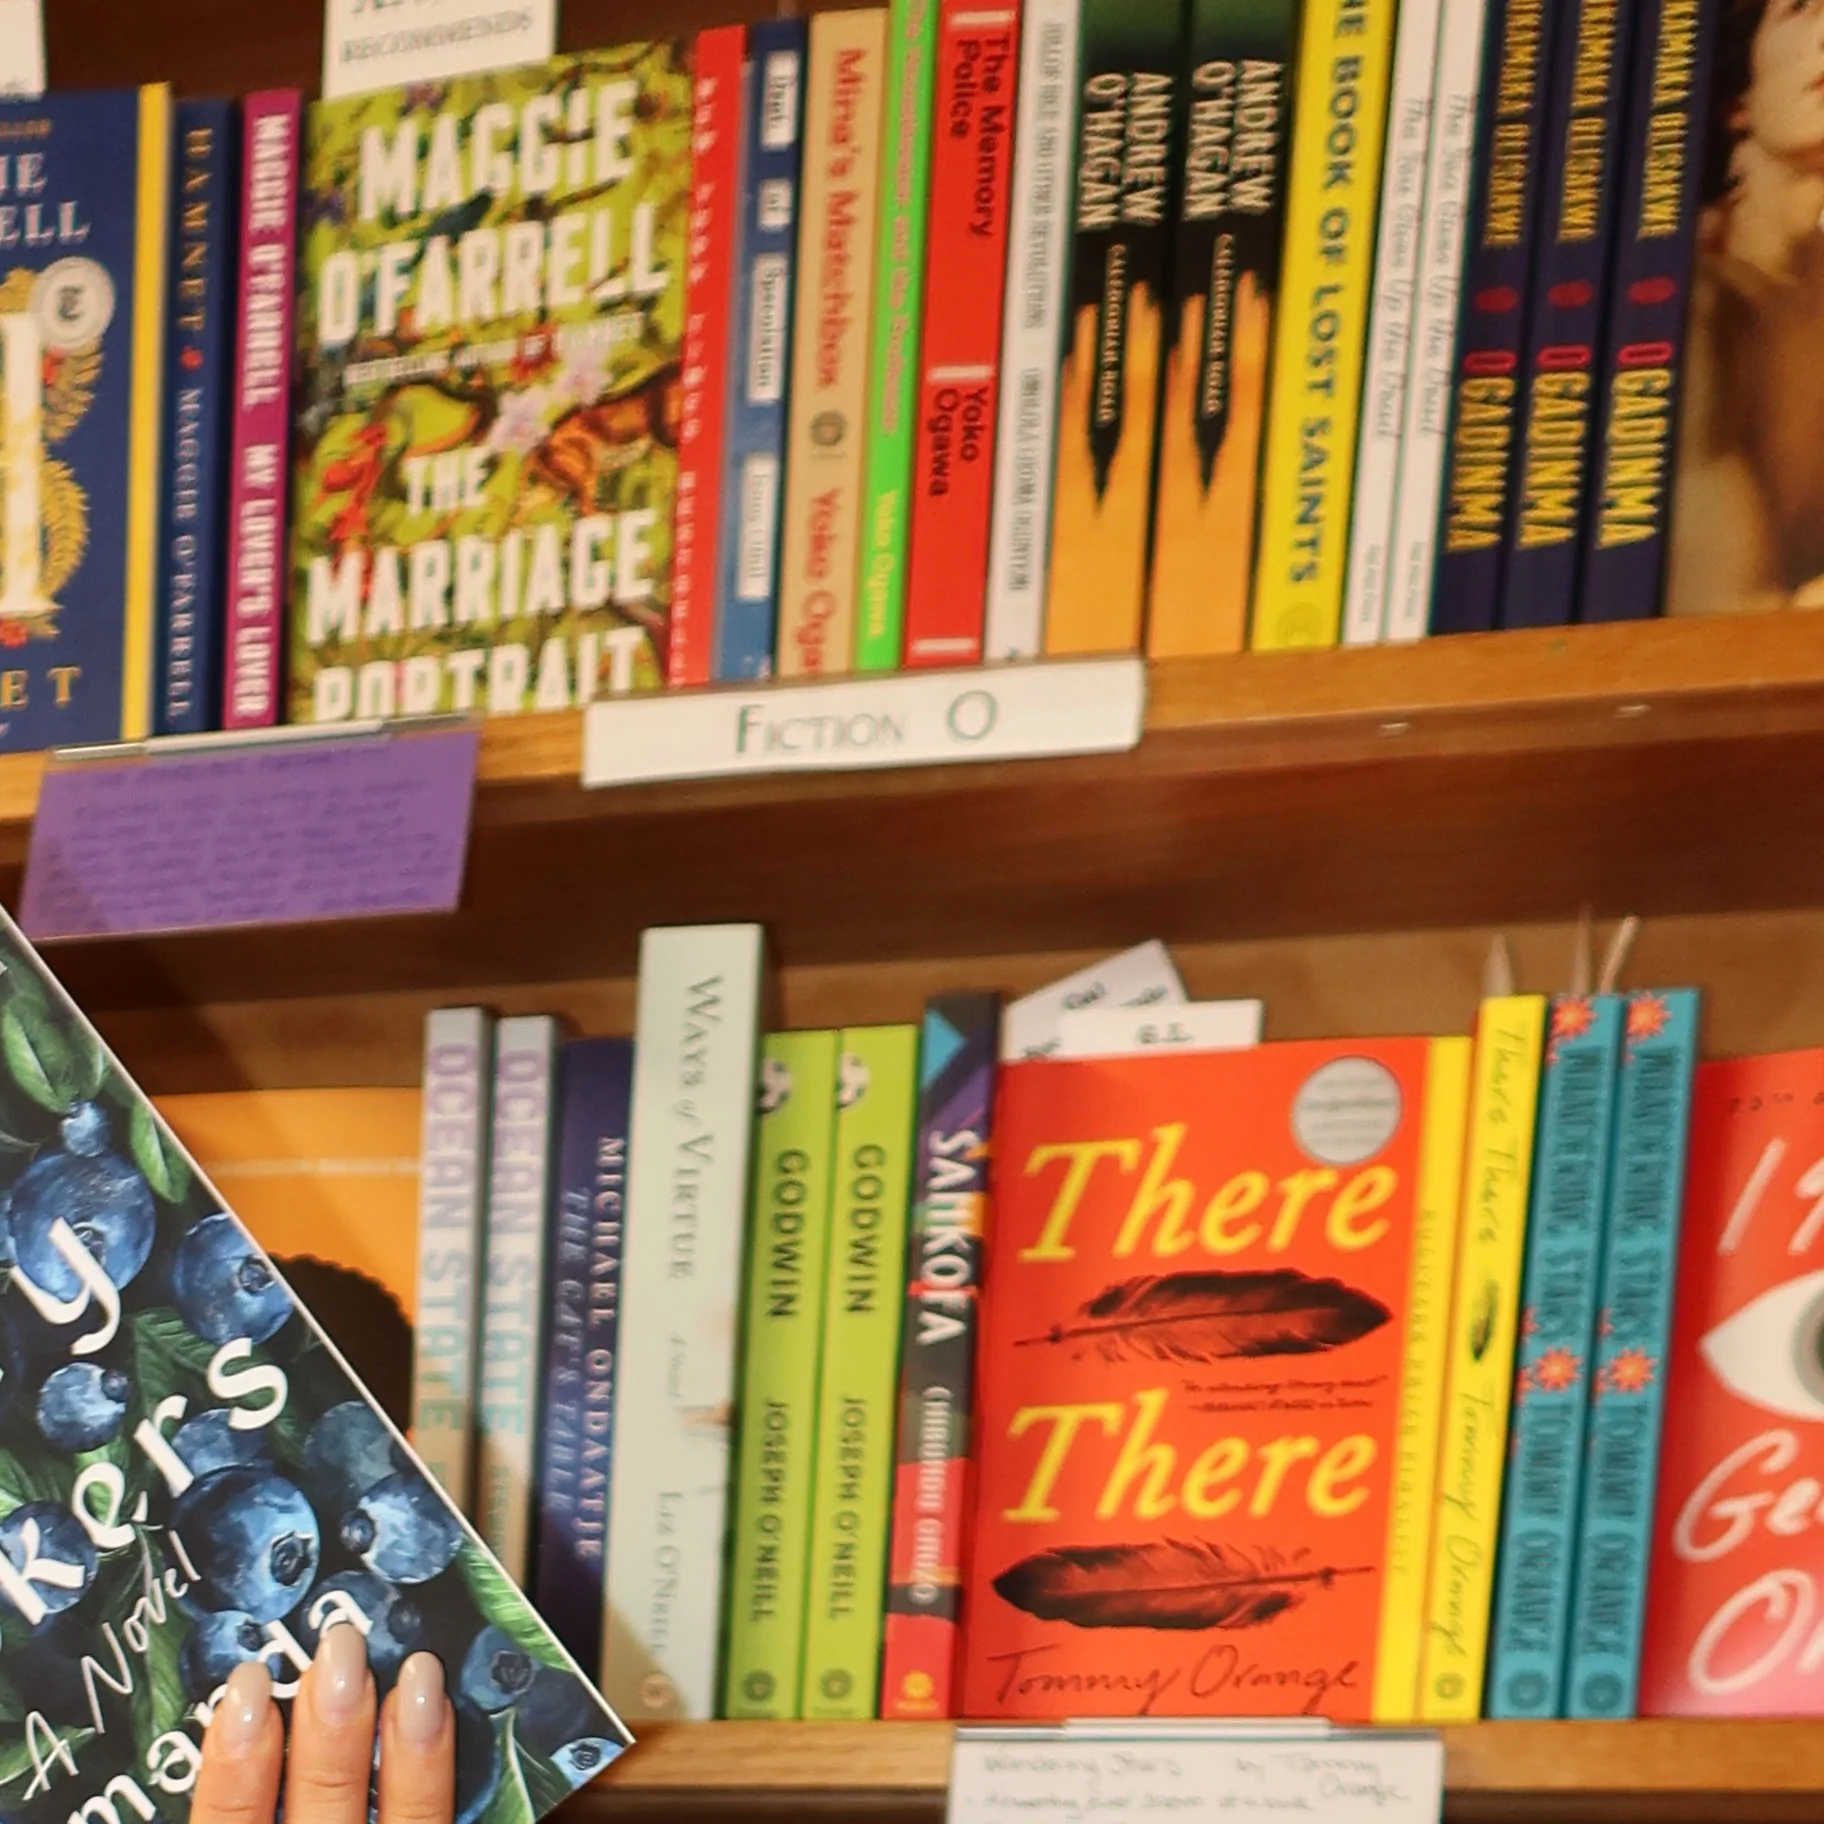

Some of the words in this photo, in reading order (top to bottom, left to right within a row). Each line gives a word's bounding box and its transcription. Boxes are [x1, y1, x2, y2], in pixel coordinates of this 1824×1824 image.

[826, 47, 866, 176] Mina's
[948, 39, 981, 139] Police
[979, 34, 1014, 90] The
[1321, 55, 1364, 191] BOOK
[249, 112, 292, 232] MAGGIE
[358, 80, 639, 222] MAGGIE
[967, 98, 1009, 239] Memory
[1077, 73, 1124, 231] O'HAGAN
[1124, 71, 1174, 226] ANDREW
[1184, 60, 1232, 223] O'HAGAN
[1229, 58, 1285, 216] ANDREW
[179, 128, 213, 332] HAMNET
[317, 201, 670, 348] O'FARRELL
[814, 189, 856, 387] Matchbox
[1316, 205, 1353, 270] OF
[242, 243, 286, 410] O'FARRELL
[1302, 281, 1344, 400] LOST
[175, 387, 202, 520] MAGGIE
[242, 443, 279, 491] MY
[402, 446, 491, 517] THE
[928, 388, 959, 497] Ogawa
[959, 387, 992, 462] Yoko
[1448, 349, 1518, 553] OGADINMA
[1520, 344, 1594, 551] OGADINMA
[1597, 341, 1676, 550] OGADINMA
[237, 499, 276, 619] LOVER'S
[803, 488, 842, 566] Yoko
[1290, 414, 1334, 586] SAINTS
[169, 533, 195, 719] O'FARRELL
[307, 509, 657, 649] MARRIAGE
[233, 626, 272, 720] LOVER
[312, 626, 646, 722] PORTRAIT
[735, 705, 907, 754] FICTION
[947, 689, 998, 742] O
[681, 974, 725, 1089] WAYS
[426, 1042, 476, 1232] OCEAN
[494, 1051, 546, 1239] OCEAN
[668, 1130, 716, 1281] VIRTUE
[1019, 1124, 1398, 1264] There
[562, 1186, 590, 1262] THE
[590, 1137, 626, 1326] MICHAEL
[766, 1149, 810, 1319] GODWIN
[843, 1142, 887, 1314] GODWIN
[915, 1127, 980, 1347] SANKOFA
[417, 1250, 470, 1433] STATE
[480, 1257, 534, 1437] STATE
[553, 1278, 586, 1386] CAT'S
[546, 1399, 579, 1509] TABLE
[576, 1348, 613, 1558] ONDAATJE
[757, 1399, 789, 1503] JOSEPH
[835, 1394, 868, 1500] JOSEPH
[1002, 1389, 1378, 1524] There
[749, 1512, 782, 1624] O'NEILL
[827, 1508, 863, 1621] O'NEILL
[23, 1708, 80, 1801] A
[80, 1530, 200, 1736] Novel
[987, 1648, 1181, 1716] Tommy
[1189, 1644, 1361, 1702] Orange
